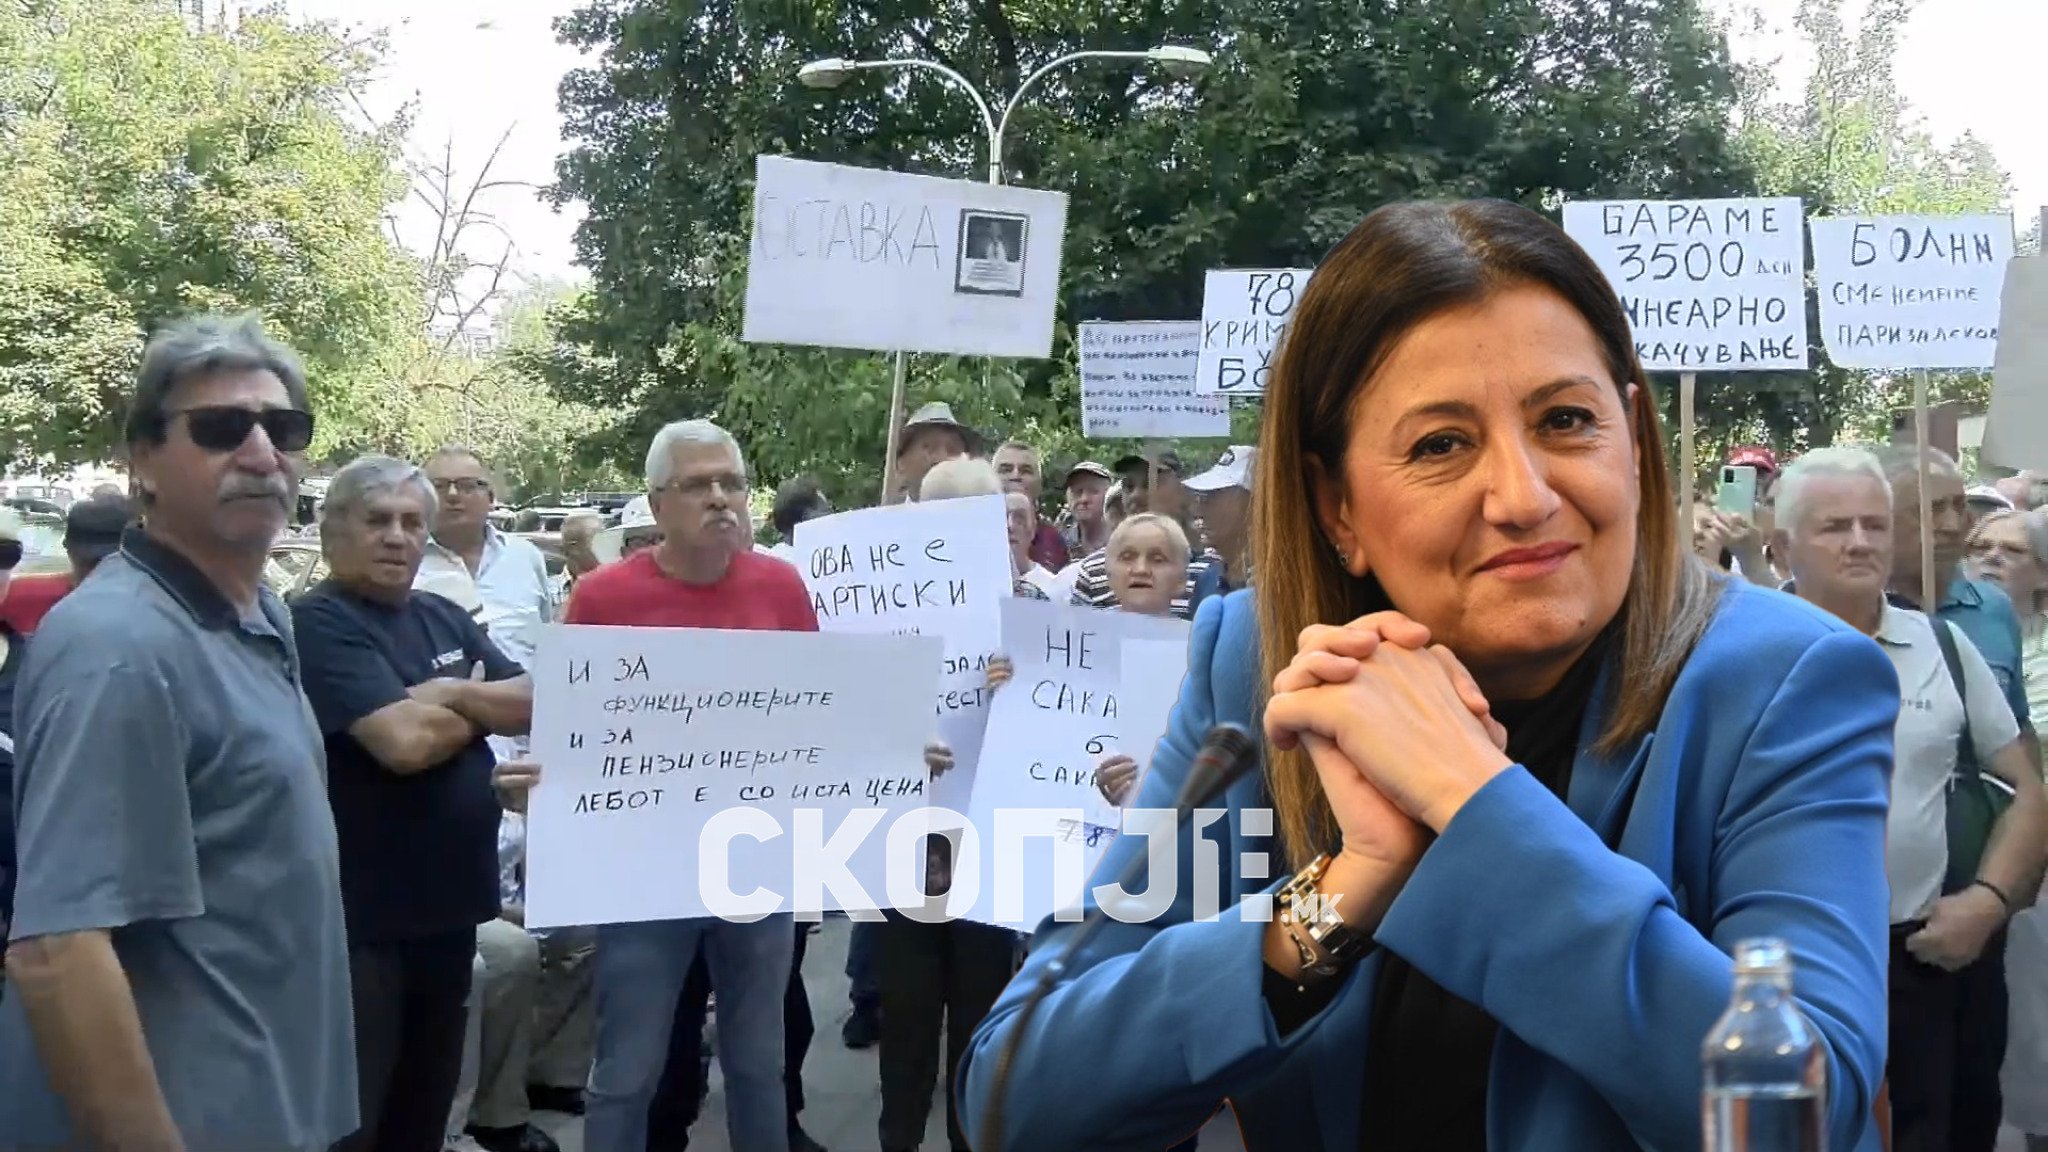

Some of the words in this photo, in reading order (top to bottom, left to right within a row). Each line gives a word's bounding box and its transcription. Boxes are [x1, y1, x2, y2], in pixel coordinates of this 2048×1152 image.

[1602, 203, 1780, 237] БАРАМЕ
[1617, 241, 1744, 282] 3500
[1851, 222, 1994, 267] БОЛНИ
[1248, 272, 1294, 316] 78
[1204, 319, 1287, 349] КРИМ
[1634, 334, 1800, 366] КАЧУВАЊЕ
[810, 544, 854, 579] ОВА
[815, 578, 967, 620] АРТИСКИ
[1045, 624, 1097, 670] НЕ
[569, 659, 591, 684] И
[613, 655, 649, 682] ЗА
[600, 726, 633, 745] ЗА
[574, 788, 665, 815] ЛЕБОТ
[694, 786, 710, 802] Е
[739, 785, 775, 801] СО
[792, 782, 852, 799] ИСТА
[866, 776, 925, 807] ЦЕНА
